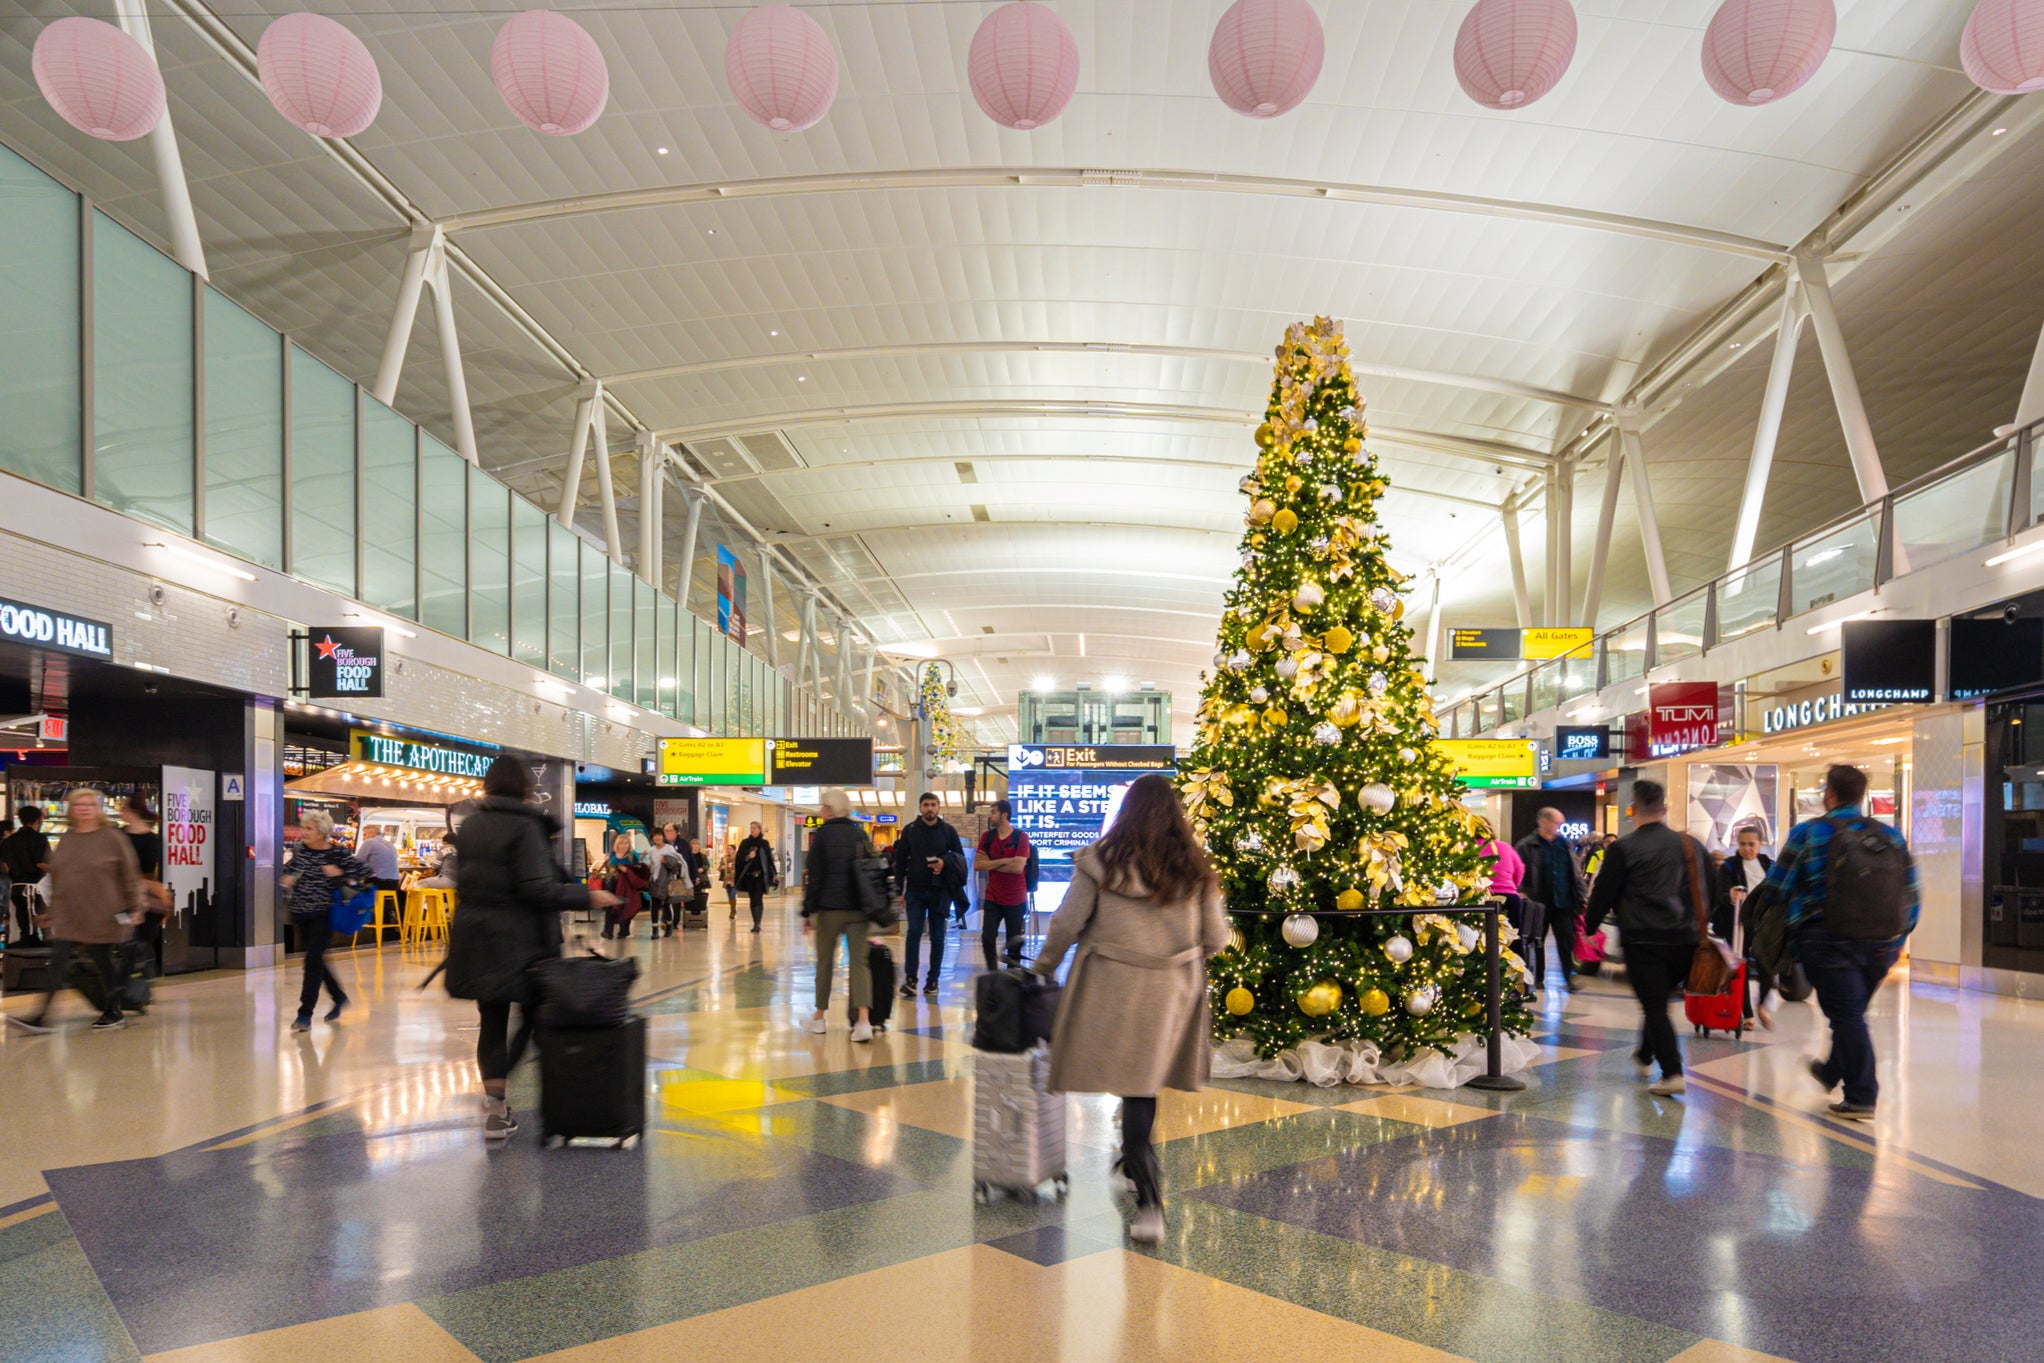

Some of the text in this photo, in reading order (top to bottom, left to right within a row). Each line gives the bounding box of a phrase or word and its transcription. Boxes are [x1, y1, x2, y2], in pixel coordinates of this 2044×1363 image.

[56, 617, 111, 655] HALL
[1536, 632, 1578, 640] All Gates
[336, 649, 354, 657] FIVE
[336, 657, 376, 666] BOROUGH
[336, 666, 372, 679] FOOD
[336, 678, 368, 691] HALL
[1851, 689, 1929, 699] LONGCHAMP
[1656, 705, 1714, 722] TUMI
[43, 718, 65, 738] EXIT
[1567, 735, 1598, 745] BOSS
[370, 735, 496, 777] THE APOTHECAR
[1066, 748, 1096, 762] Exit
[227, 778, 240, 793] A
[1017, 784, 1114, 799] IF IT SEEMS
[167, 793, 187, 808] FIVE
[1017, 800, 1111, 814] LIKE A STE
[167, 808, 212, 823] BOROUGH
[1017, 815, 1060, 829] IT IS.
[167, 824, 206, 844] FOOD
[1557, 823, 1588, 835] OSS
[167, 845, 203, 865] HALL
